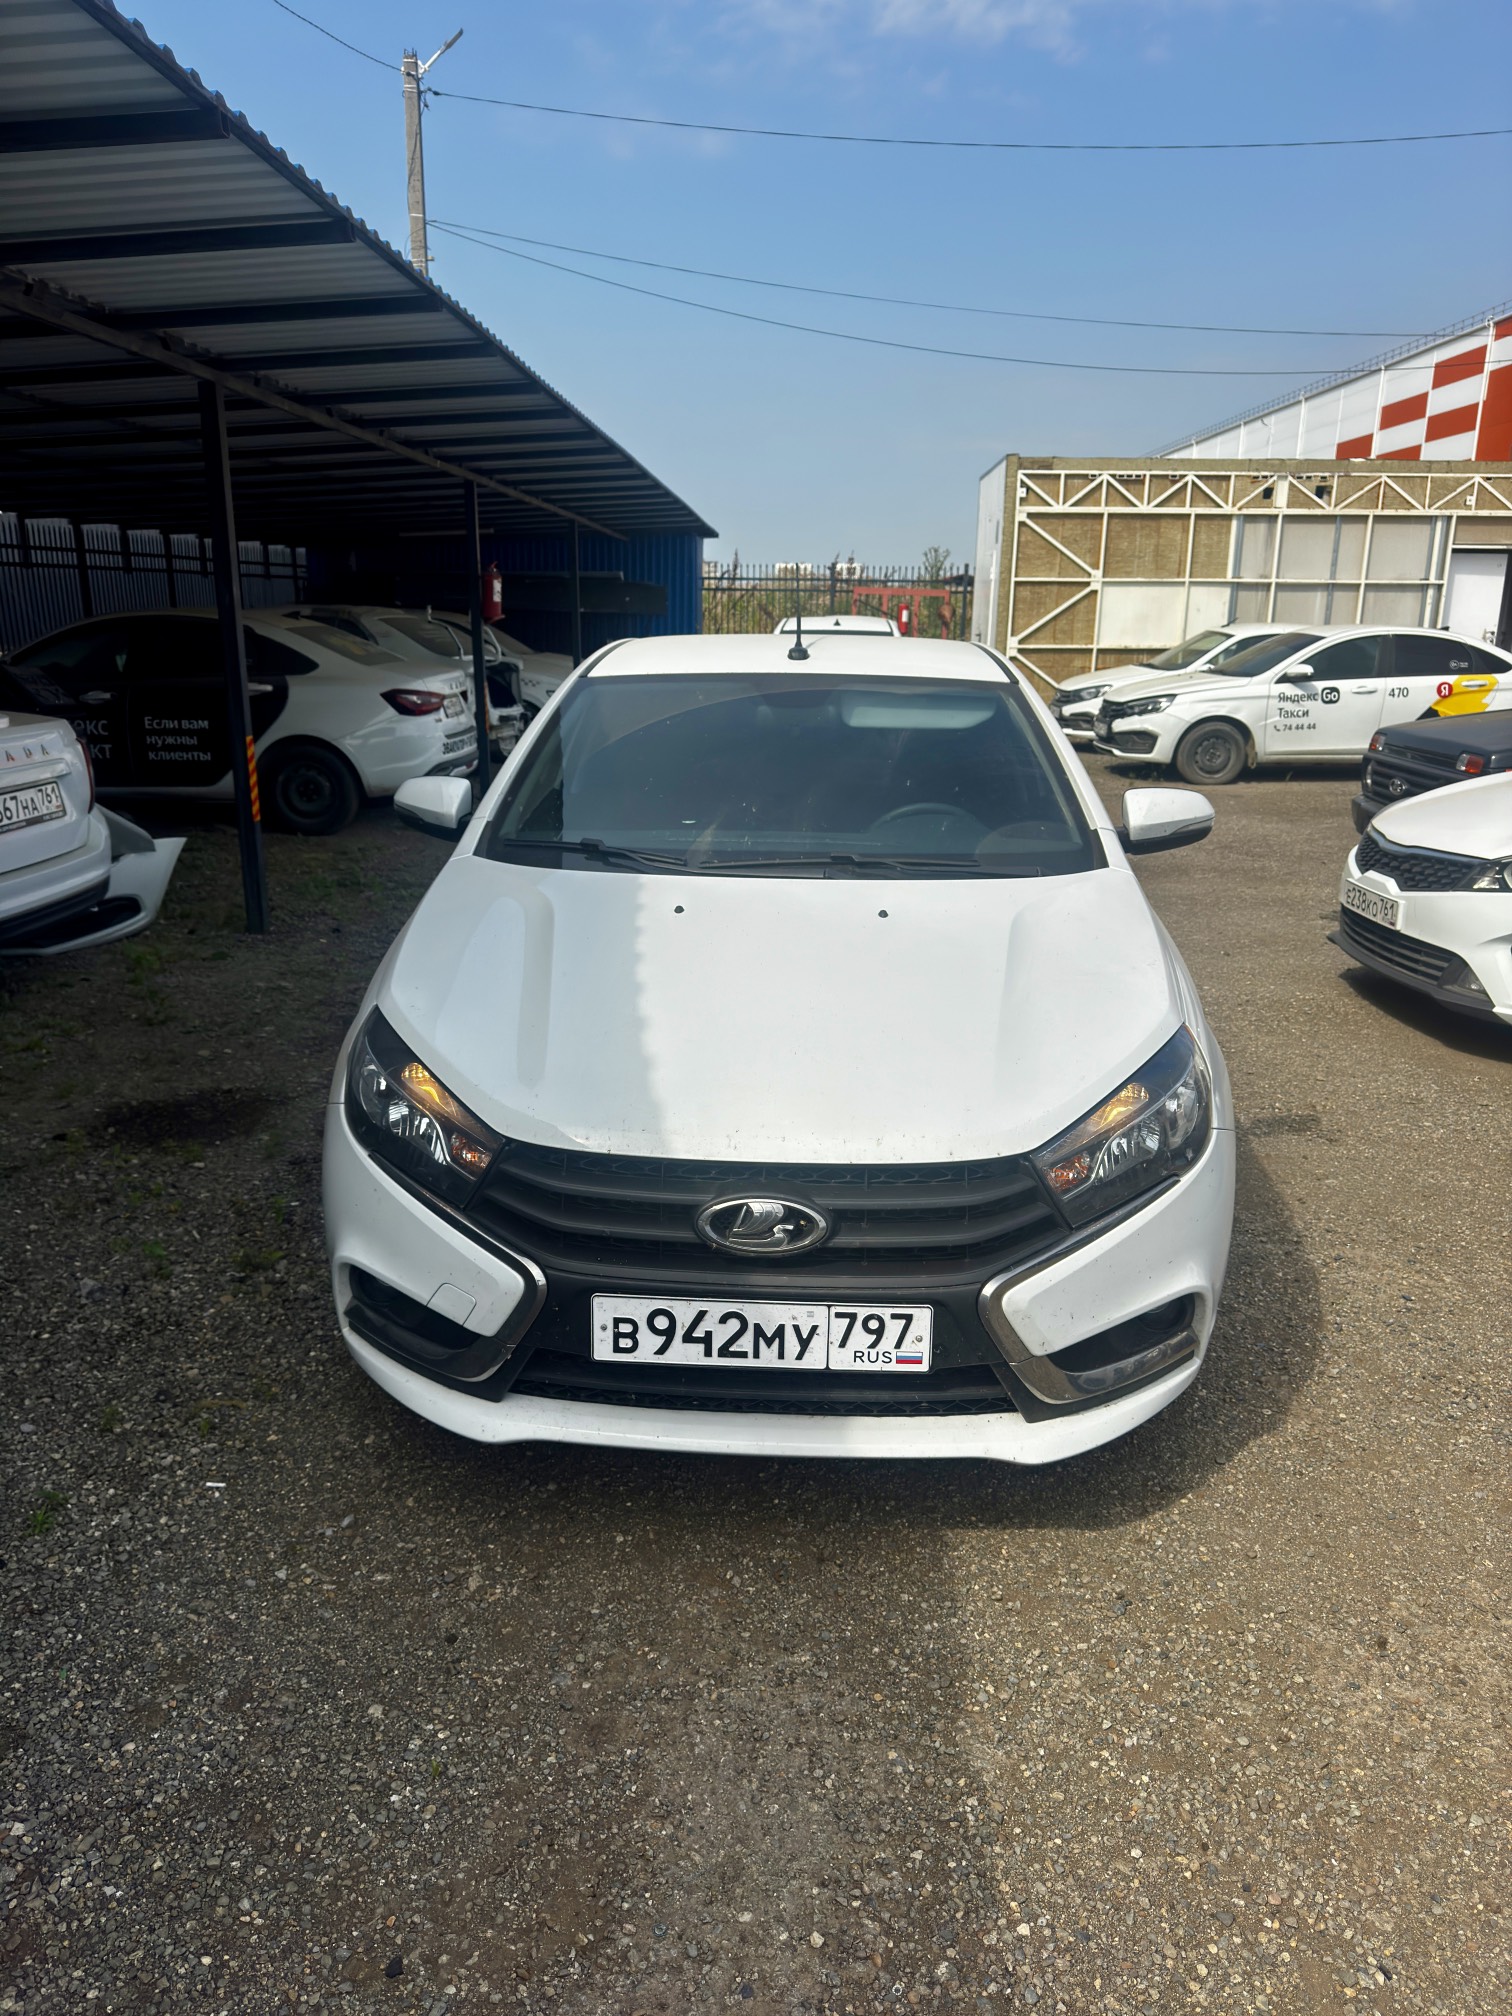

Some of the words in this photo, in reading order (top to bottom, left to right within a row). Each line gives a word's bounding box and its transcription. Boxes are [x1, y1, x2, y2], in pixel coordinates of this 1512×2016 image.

[1278, 692, 1319, 703] Яндекс
[1322, 689, 1339, 702] Go
[1388, 687, 1409, 698] 470
[1277, 708, 1309, 719] Такси
[144, 716, 178, 730] Если
[181, 719, 209, 730] вам
[1282, 724, 1293, 732] 74
[146, 735, 198, 748] нужны
[148, 751, 212, 761] клиенты
[37, 785, 59, 807] 761
[1379, 898, 1395, 920] 761
[612, 1307, 820, 1361] В942МУ
[834, 1311, 914, 1350] 797
[853, 1350, 893, 1364] RUS
